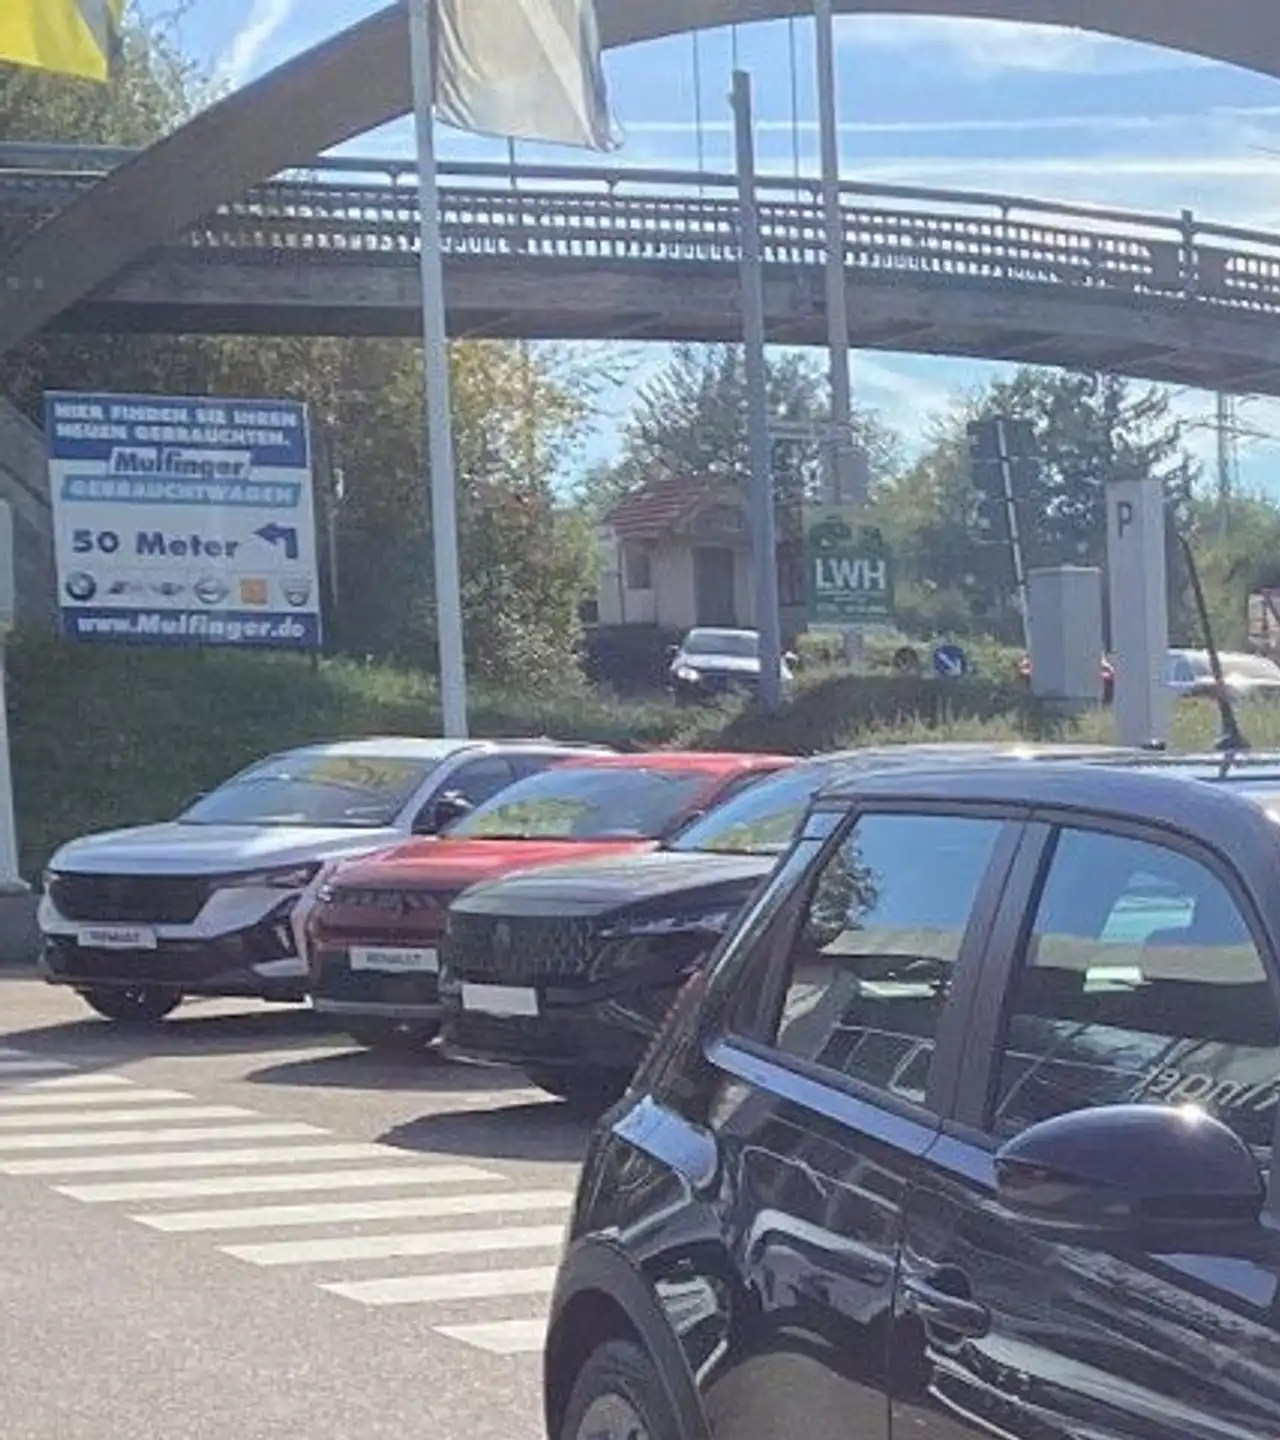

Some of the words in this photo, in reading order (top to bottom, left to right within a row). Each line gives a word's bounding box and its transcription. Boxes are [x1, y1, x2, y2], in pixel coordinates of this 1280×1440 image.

[110, 405, 188, 422] FINDEN
[196, 407, 227, 424] SIE
[234, 410, 297, 427] IHREN
[56, 423, 127, 439] NEUEN
[114, 450, 244, 478] Mulfinger
[68, 480, 294, 501] GEBRAUCHTWAGEN
[72, 530, 120, 553] 50
[137, 531, 240, 558] Meter
[816, 558, 886, 590] LWH
[77, 614, 306, 640] www.Mulfinger.de
